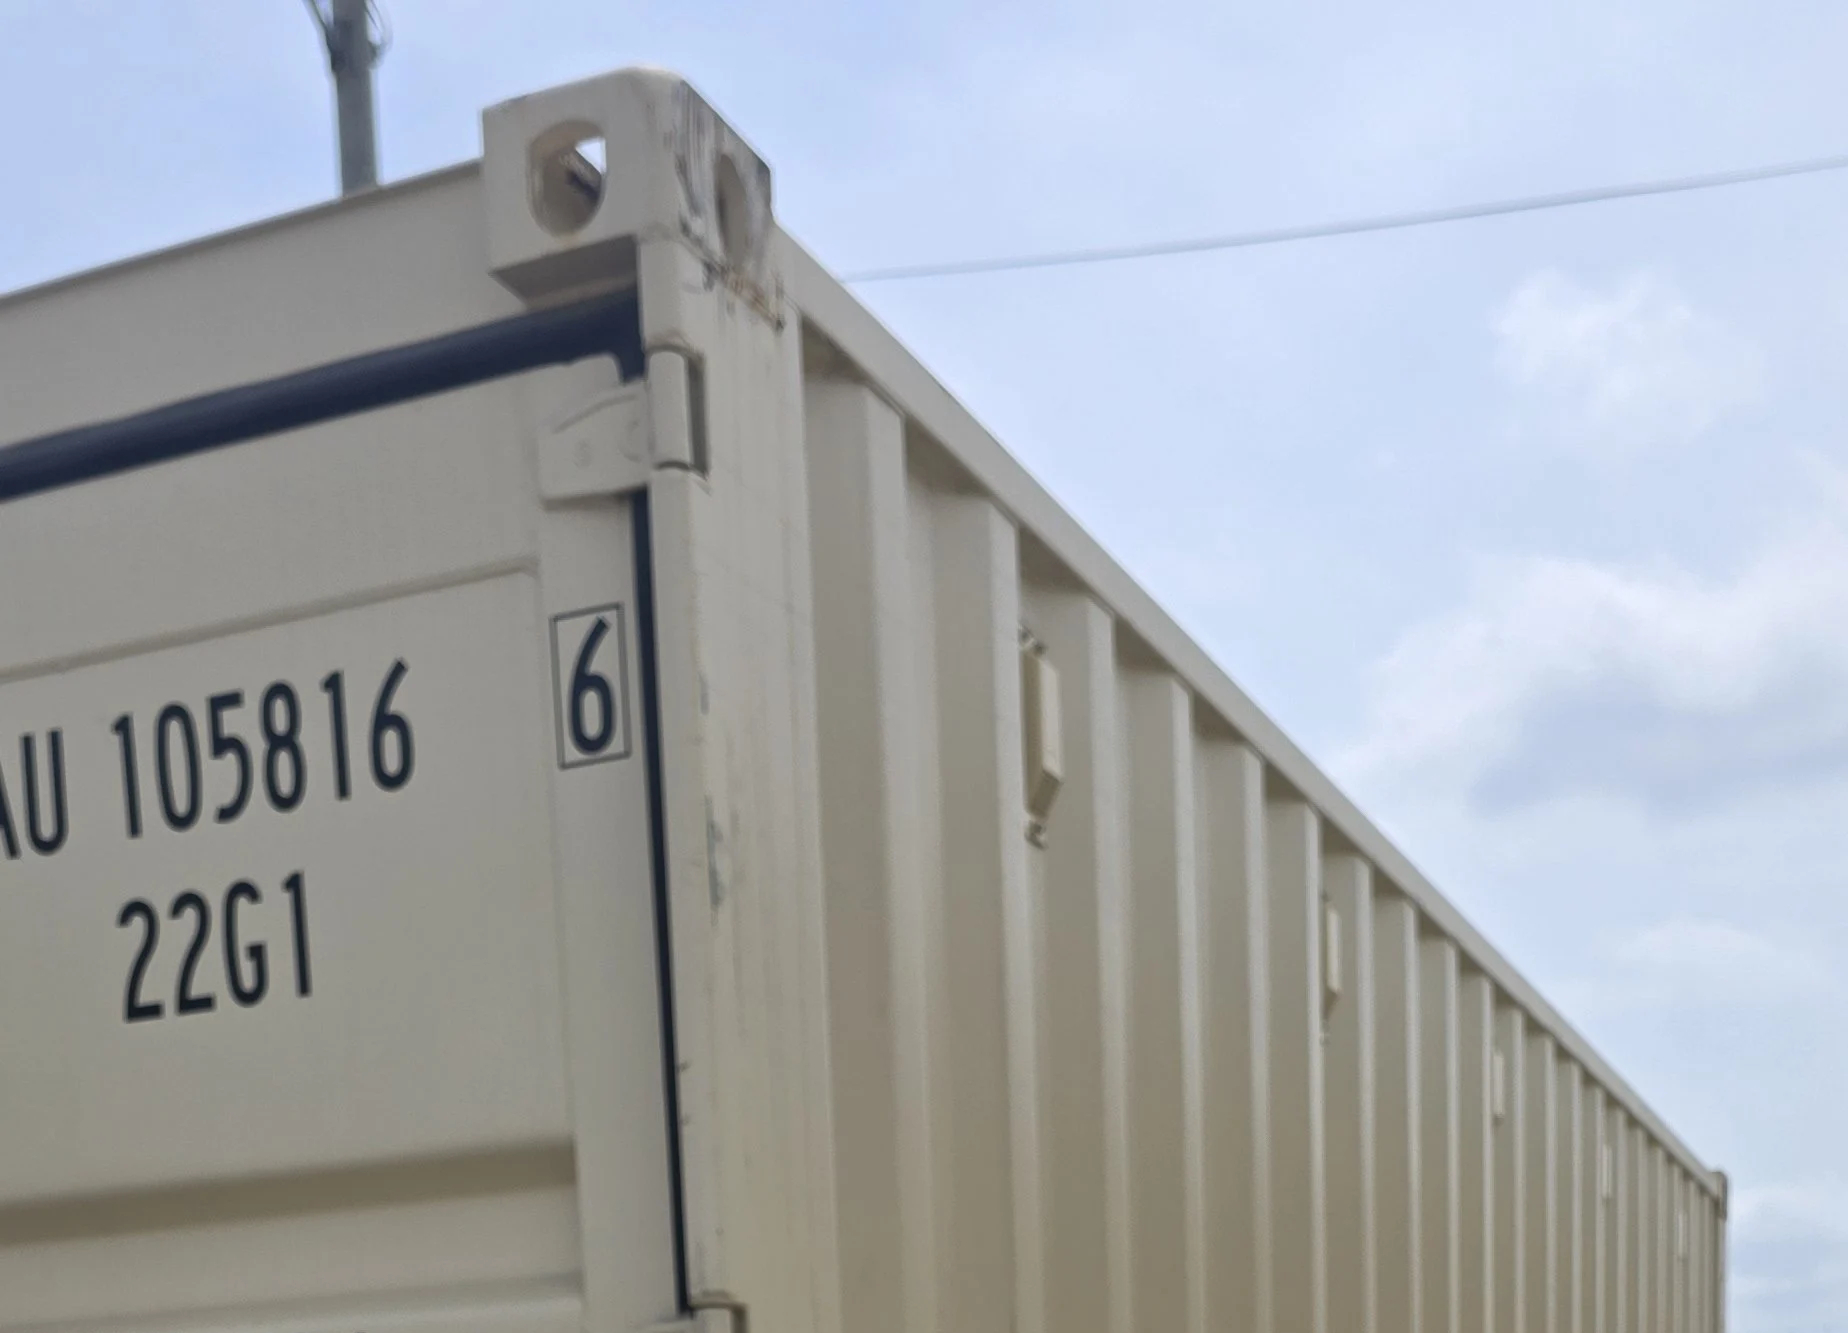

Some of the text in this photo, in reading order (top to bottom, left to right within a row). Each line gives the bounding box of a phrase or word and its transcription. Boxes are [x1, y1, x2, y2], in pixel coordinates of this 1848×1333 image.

[111, 658, 415, 839] 105816
[569, 616, 616, 756] 6
[116, 870, 312, 1023] 22G1
